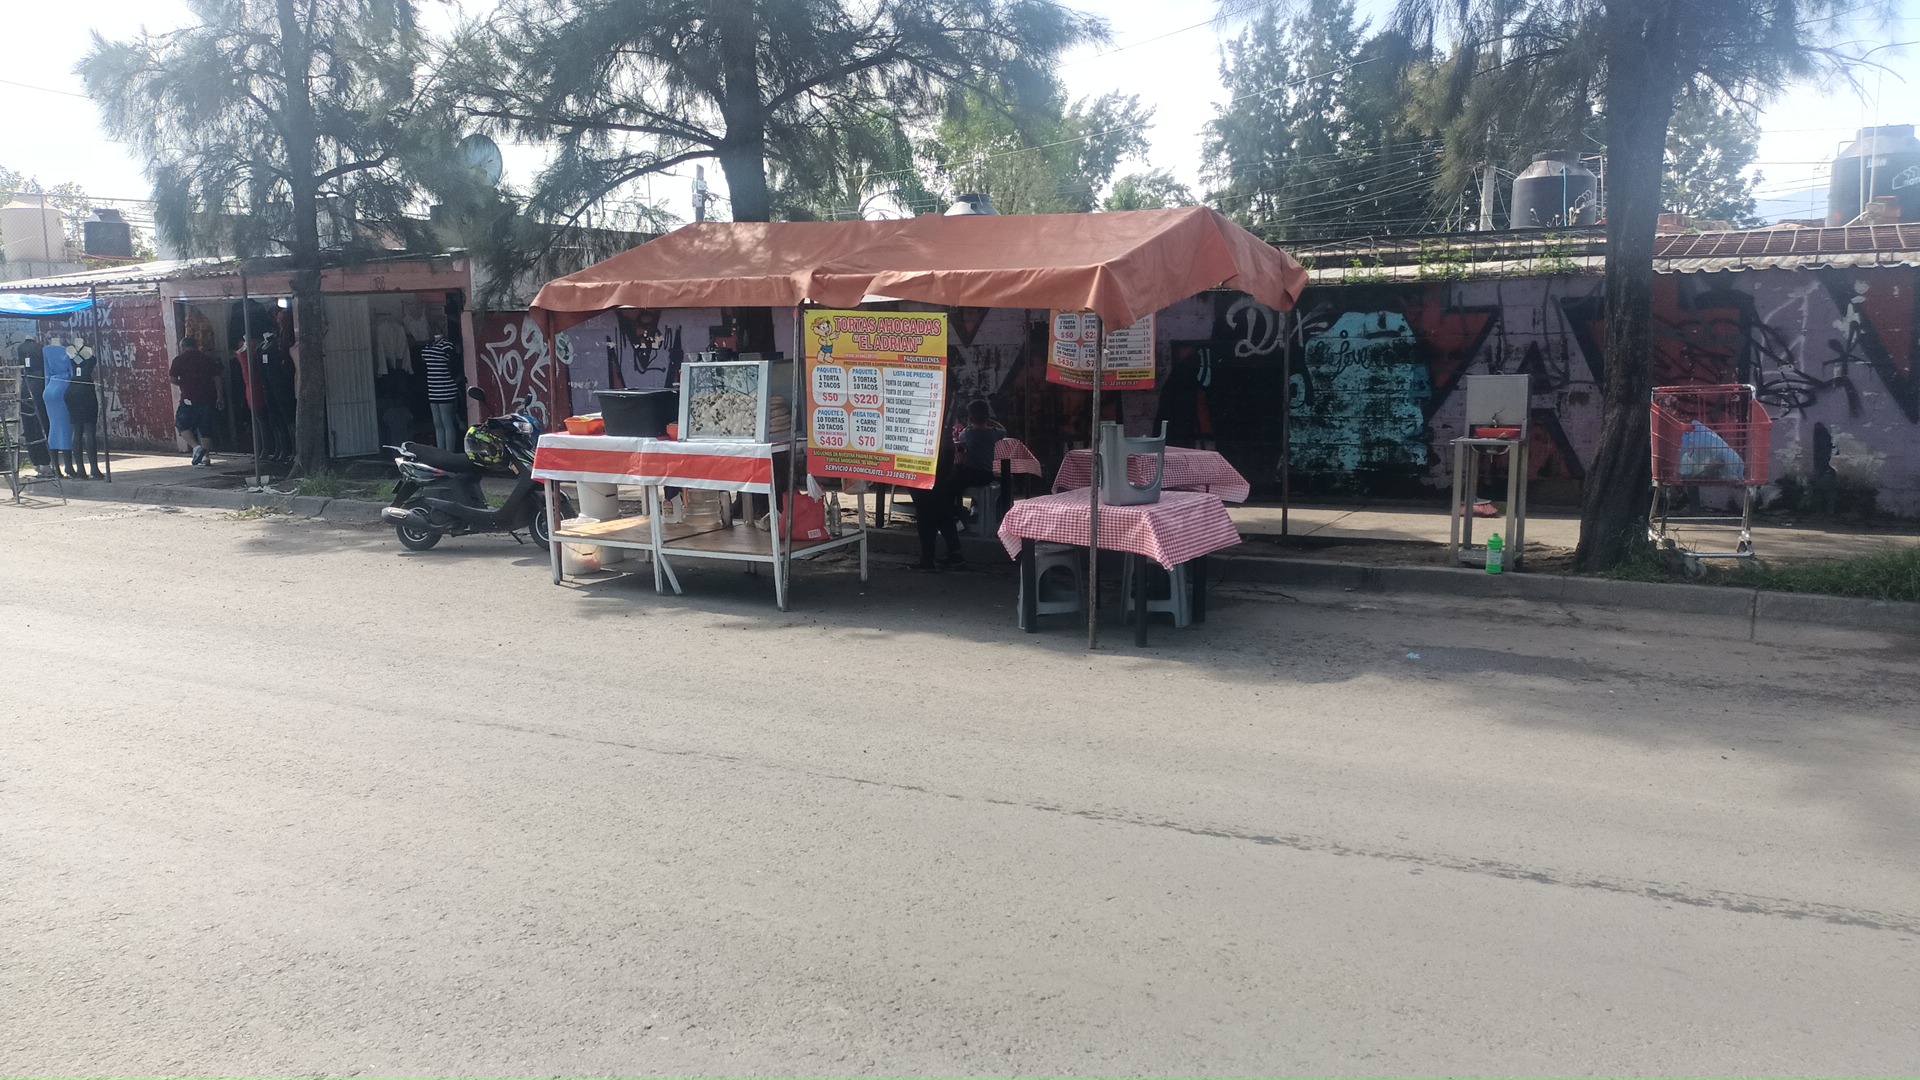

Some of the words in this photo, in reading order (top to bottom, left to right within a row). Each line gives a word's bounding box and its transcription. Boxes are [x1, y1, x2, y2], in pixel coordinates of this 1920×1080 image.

[834, 316, 876, 333] TORTAS
[877, 317, 941, 335] AHOGADAS
[823, 392, 838, 401] $50
[854, 393, 878, 404] $220
[820, 436, 843, 446] $430
[859, 436, 875, 447] $70
